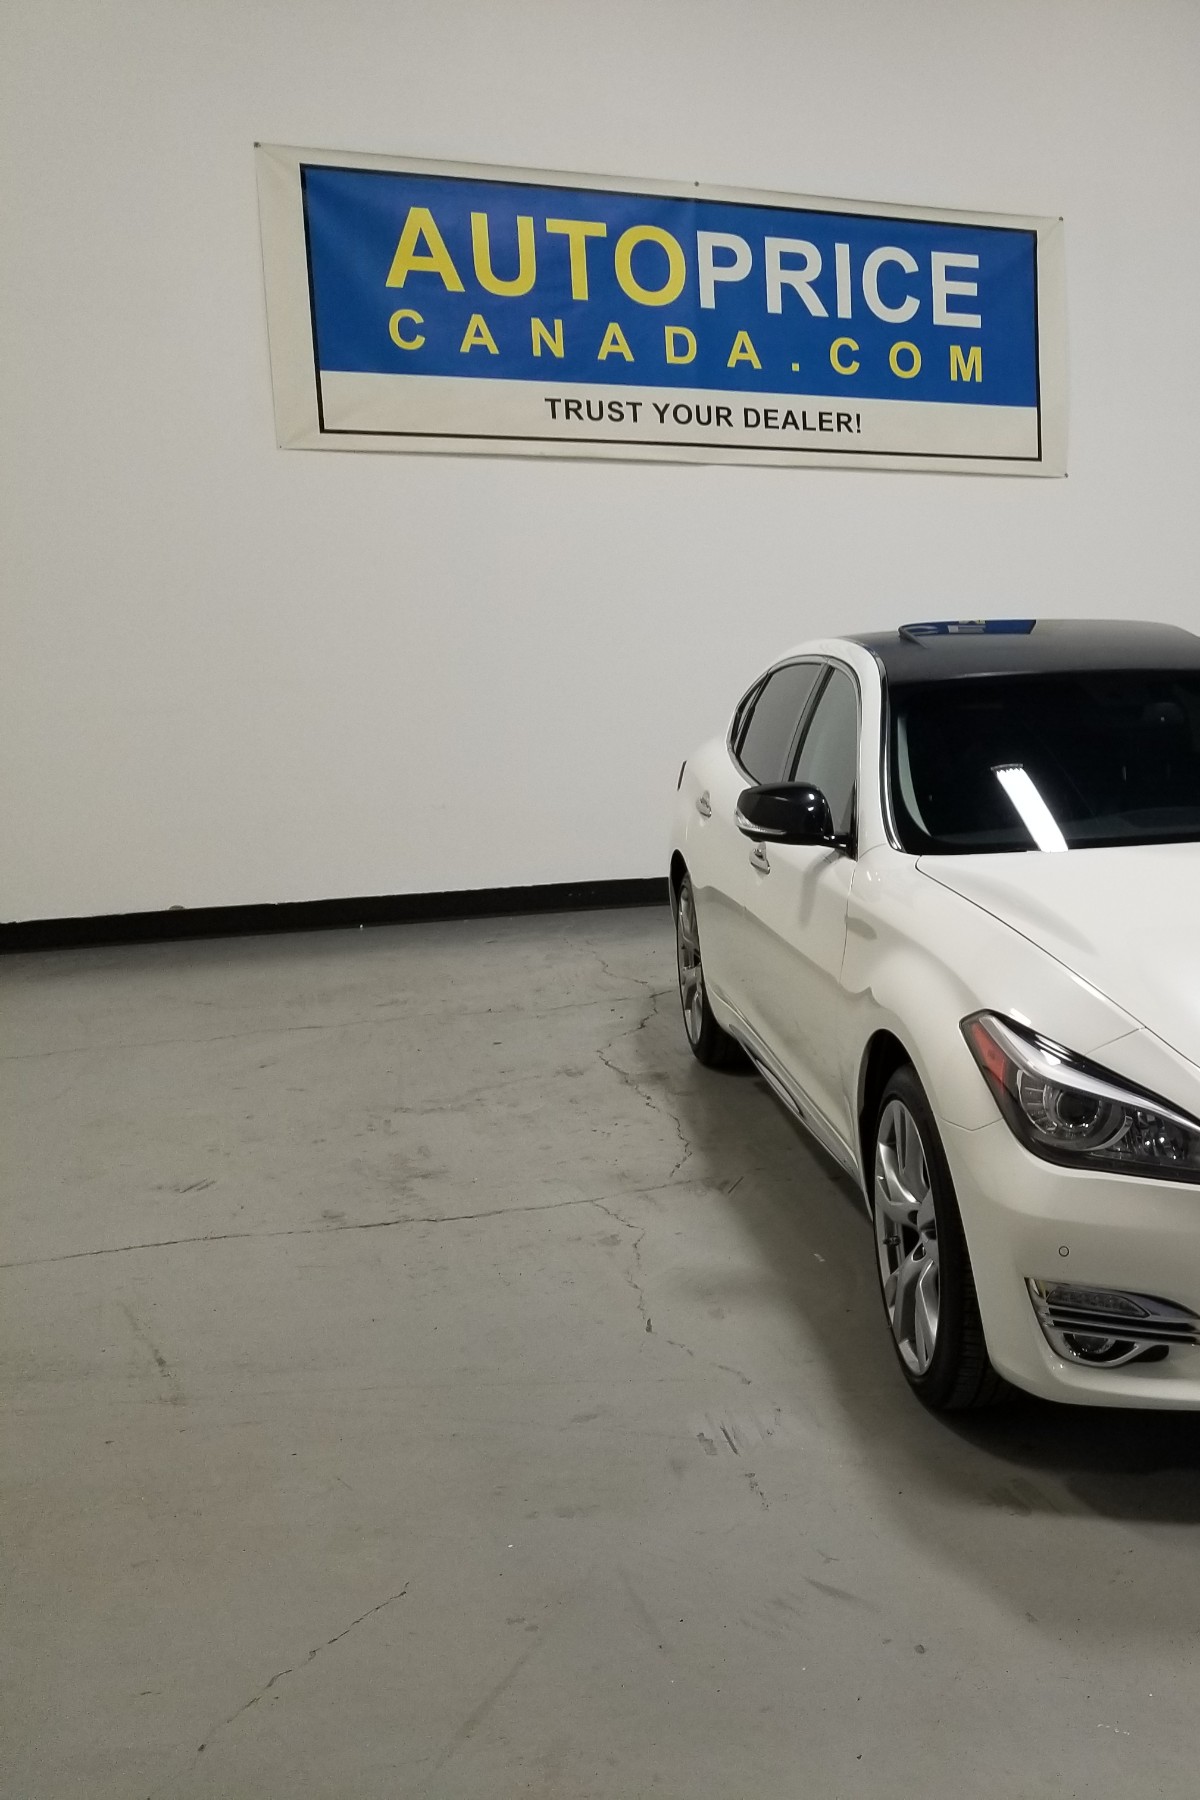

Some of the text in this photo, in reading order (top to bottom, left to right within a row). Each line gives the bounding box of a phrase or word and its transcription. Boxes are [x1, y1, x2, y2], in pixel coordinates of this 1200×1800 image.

[385, 206, 983, 329] AUTOPRICE
[388, 308, 984, 383] CANADA.COM
[544, 397, 863, 434] TRUST YOUR DEALER!
